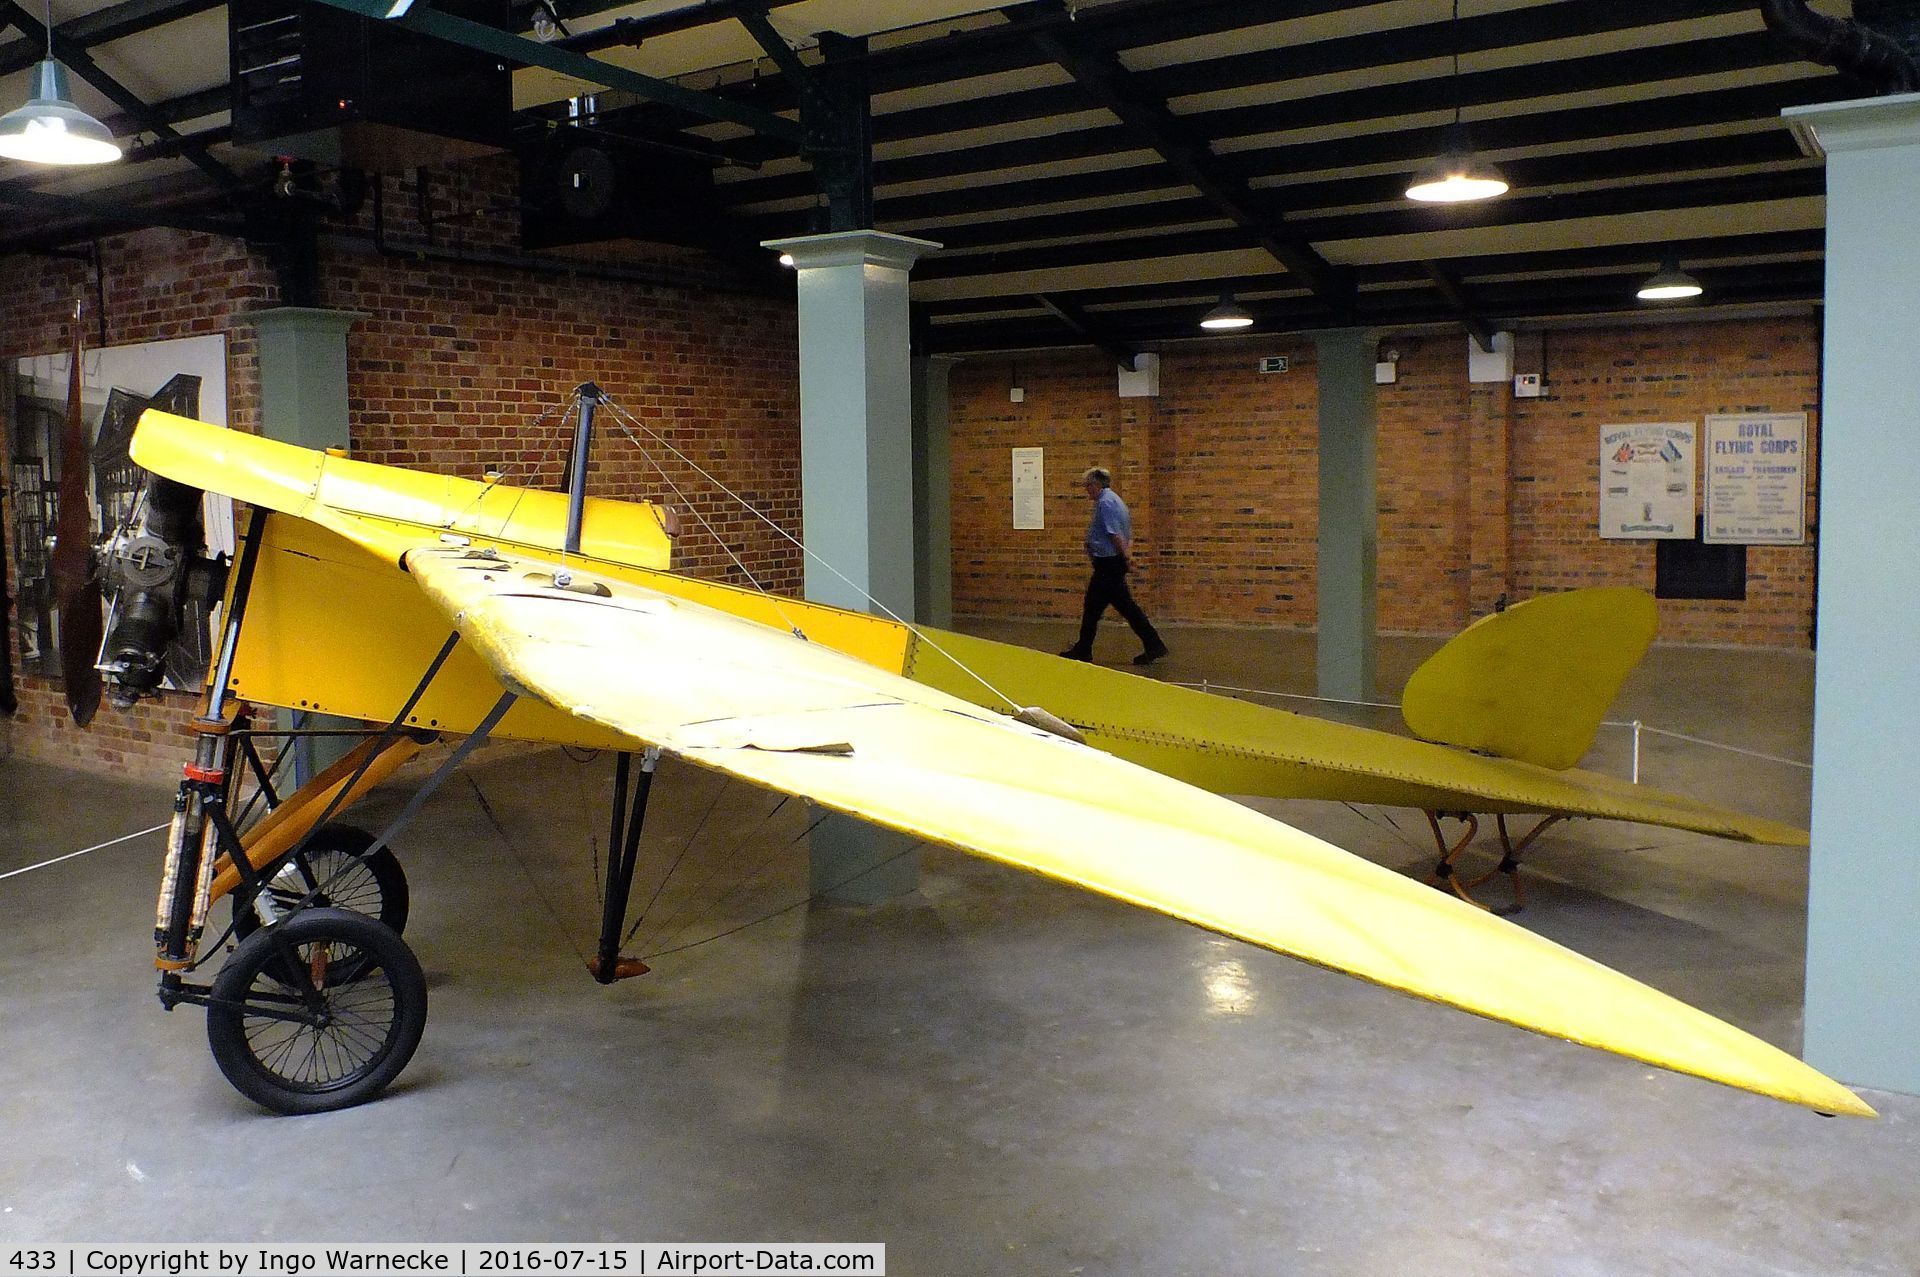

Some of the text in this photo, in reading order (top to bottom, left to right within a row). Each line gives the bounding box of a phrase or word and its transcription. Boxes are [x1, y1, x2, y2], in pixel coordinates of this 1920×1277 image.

[1738, 423, 1774, 438] ROYAL
[1715, 439, 1798, 455] FLYING CORPS
